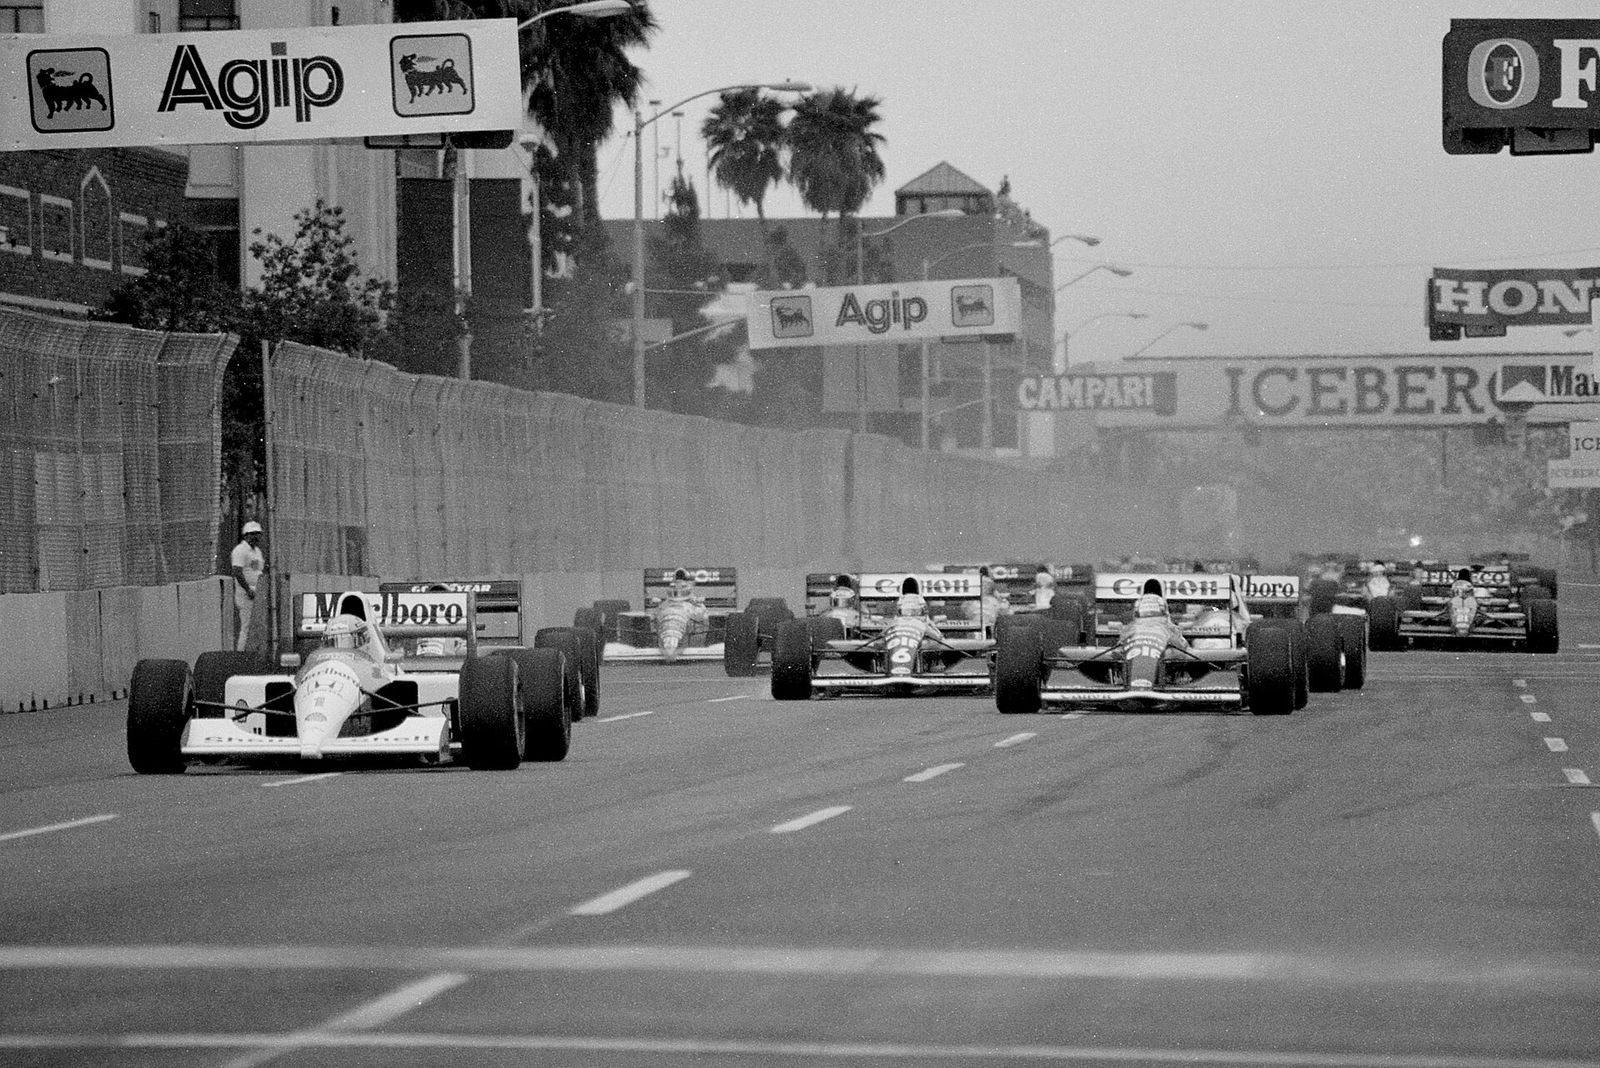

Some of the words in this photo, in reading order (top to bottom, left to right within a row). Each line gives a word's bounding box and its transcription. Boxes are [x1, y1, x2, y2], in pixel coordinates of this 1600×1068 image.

[157, 42, 345, 129] Agip
[1434, 279, 1600, 315] HON
[835, 290, 929, 334] Agip
[1017, 376, 1153, 408] CAMPARI
[410, 582, 492, 593] GOYEAR
[874, 577, 970, 594] Cnon
[1112, 578, 1218, 596] Cnon
[1240, 574, 1295, 598] lboro
[315, 592, 464, 626] Mlboro
[891, 648, 911, 663] 6
